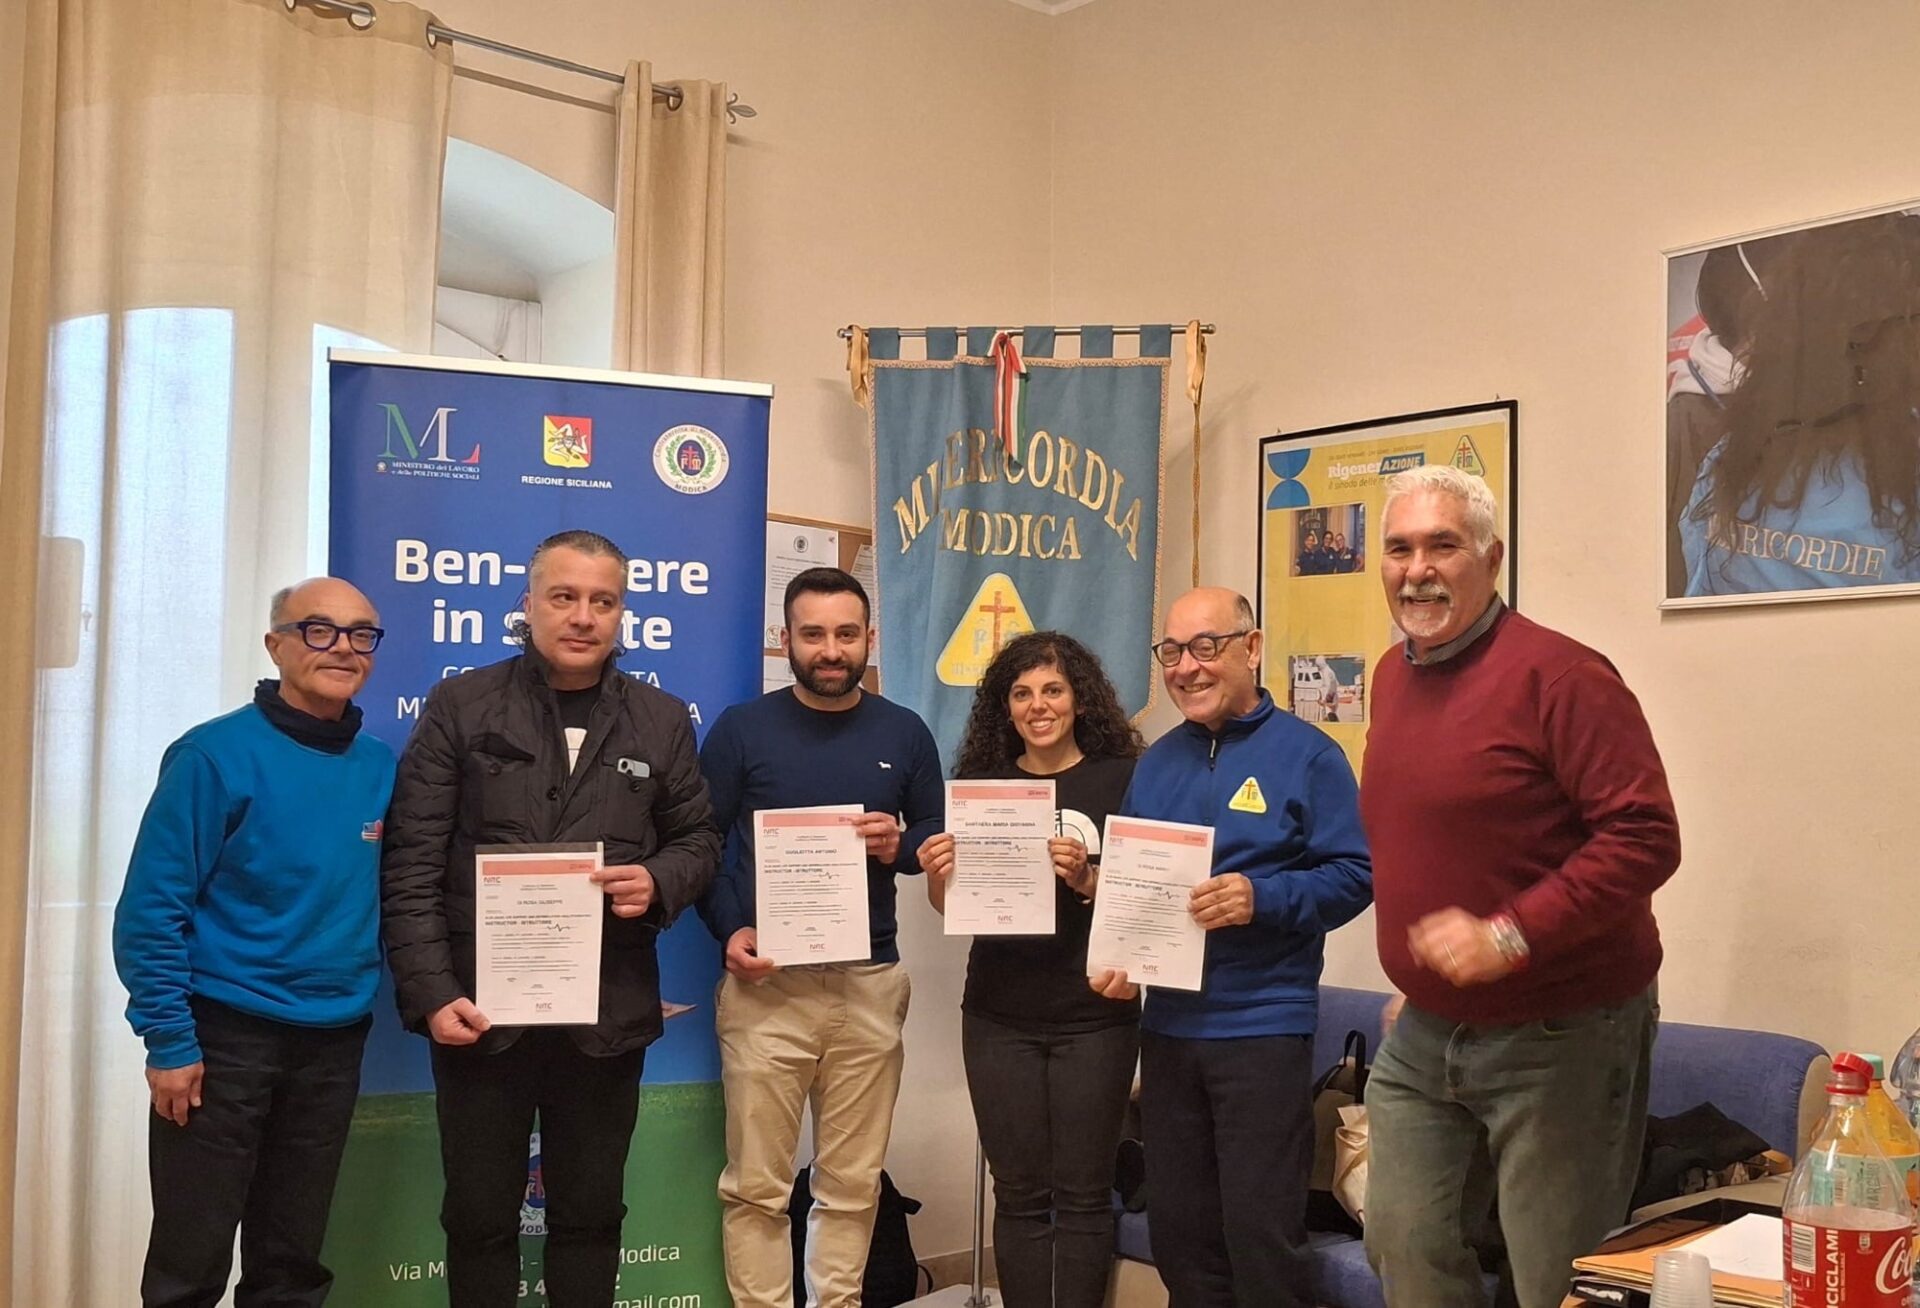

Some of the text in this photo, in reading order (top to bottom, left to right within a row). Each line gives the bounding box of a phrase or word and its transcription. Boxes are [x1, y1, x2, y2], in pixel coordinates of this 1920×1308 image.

[521, 476, 612, 489] REGIONE SICILIANA
[893, 428, 1142, 561] MIERICORDIA
[940, 508, 1081, 560] MODICA
[1705, 513, 1886, 580] RICORDIE
[395, 539, 709, 594] Ben-ere
[433, 598, 672, 650] in ste
[389, 1262, 421, 1281] Via
[1826, 1229, 1839, 1308] ICICLAMI
